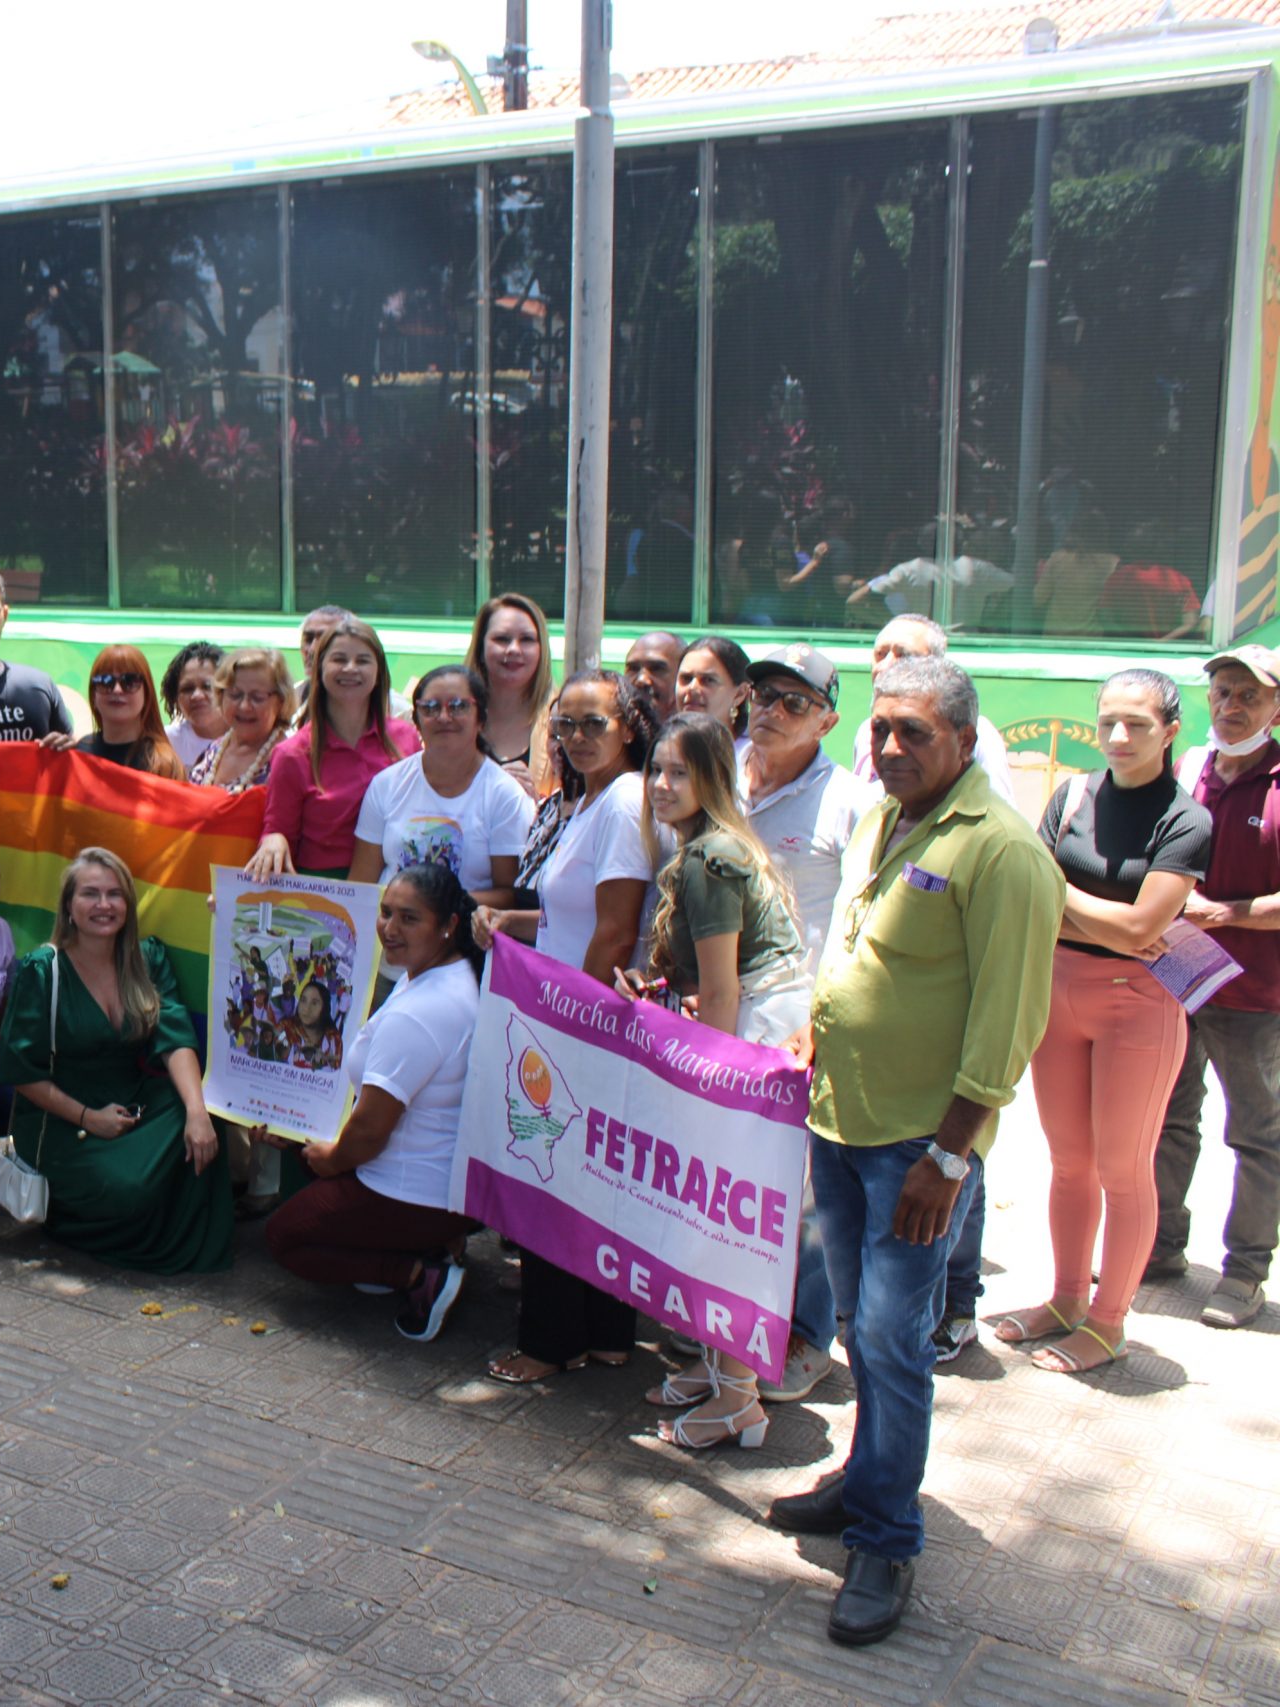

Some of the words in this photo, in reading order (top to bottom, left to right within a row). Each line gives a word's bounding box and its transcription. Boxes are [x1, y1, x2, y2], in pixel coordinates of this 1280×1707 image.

[285, 880, 335, 895] MARGARIDAS
[336, 886, 355, 897] 2023
[537, 980, 619, 1036] Marcha
[625, 1015, 656, 1054] das
[656, 1037, 797, 1106] Margaridas
[585, 1106, 787, 1248] FETRAECE
[596, 1243, 773, 1367] CEARÁ
[734, 1241, 746, 1250] no
[749, 1246, 781, 1264] campo.
